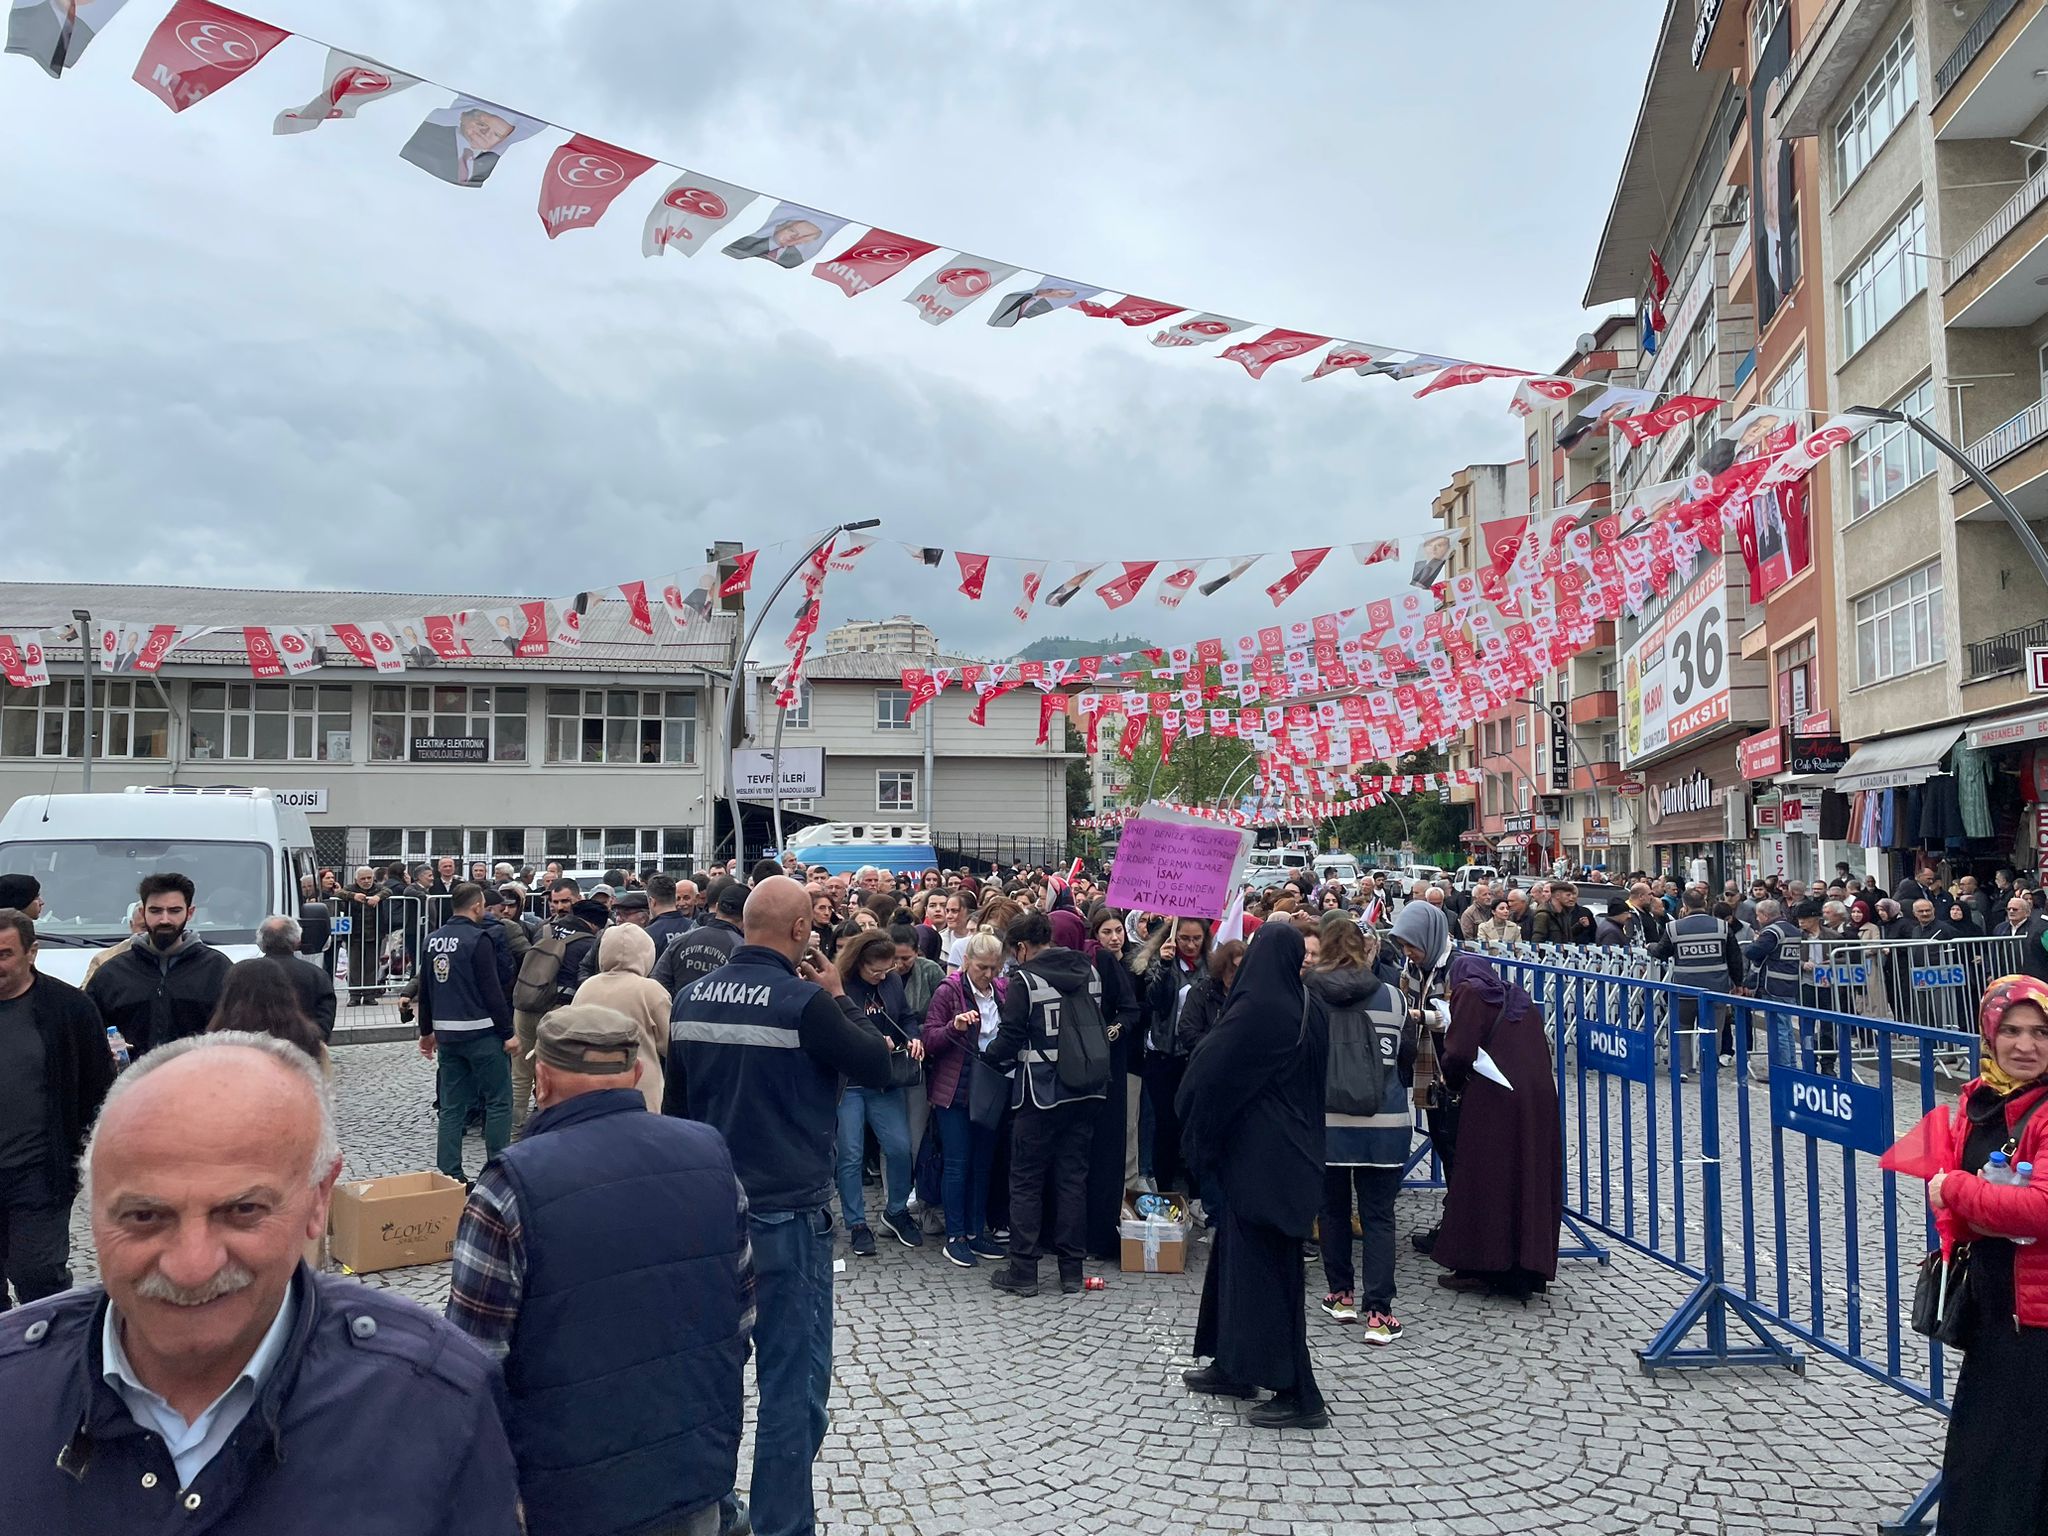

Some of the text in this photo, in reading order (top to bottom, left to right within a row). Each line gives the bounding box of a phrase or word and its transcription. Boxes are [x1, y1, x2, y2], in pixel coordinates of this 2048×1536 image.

[547, 204, 592, 227] MHP
[916, 293, 953, 319] MHP
[1666, 591, 1688, 631] KREDİ
[1672, 605, 1723, 705] 36
[1671, 696, 1729, 738] TAKSİT
[1552, 705, 1566, 764] OTEL
[1981, 725, 2025, 743] HASTANELER
[782, 771, 806, 783] İLERİ
[1859, 775, 1890, 788] KARADURAN
[736, 787, 755, 795] MESLEKİ
[756, 787, 762, 795] VE
[779, 786, 802, 794] ANADOLU
[1760, 810, 1774, 823] E
[1121, 838, 1142, 850] ONA
[1157, 881, 1167, 890] O
[1170, 882, 1216, 894] GEMİDEN
[690, 981, 771, 1007] S.AKKAYA
[1590, 1030, 1627, 1059] POLİS
[1793, 1081, 1853, 1121] POLİS
